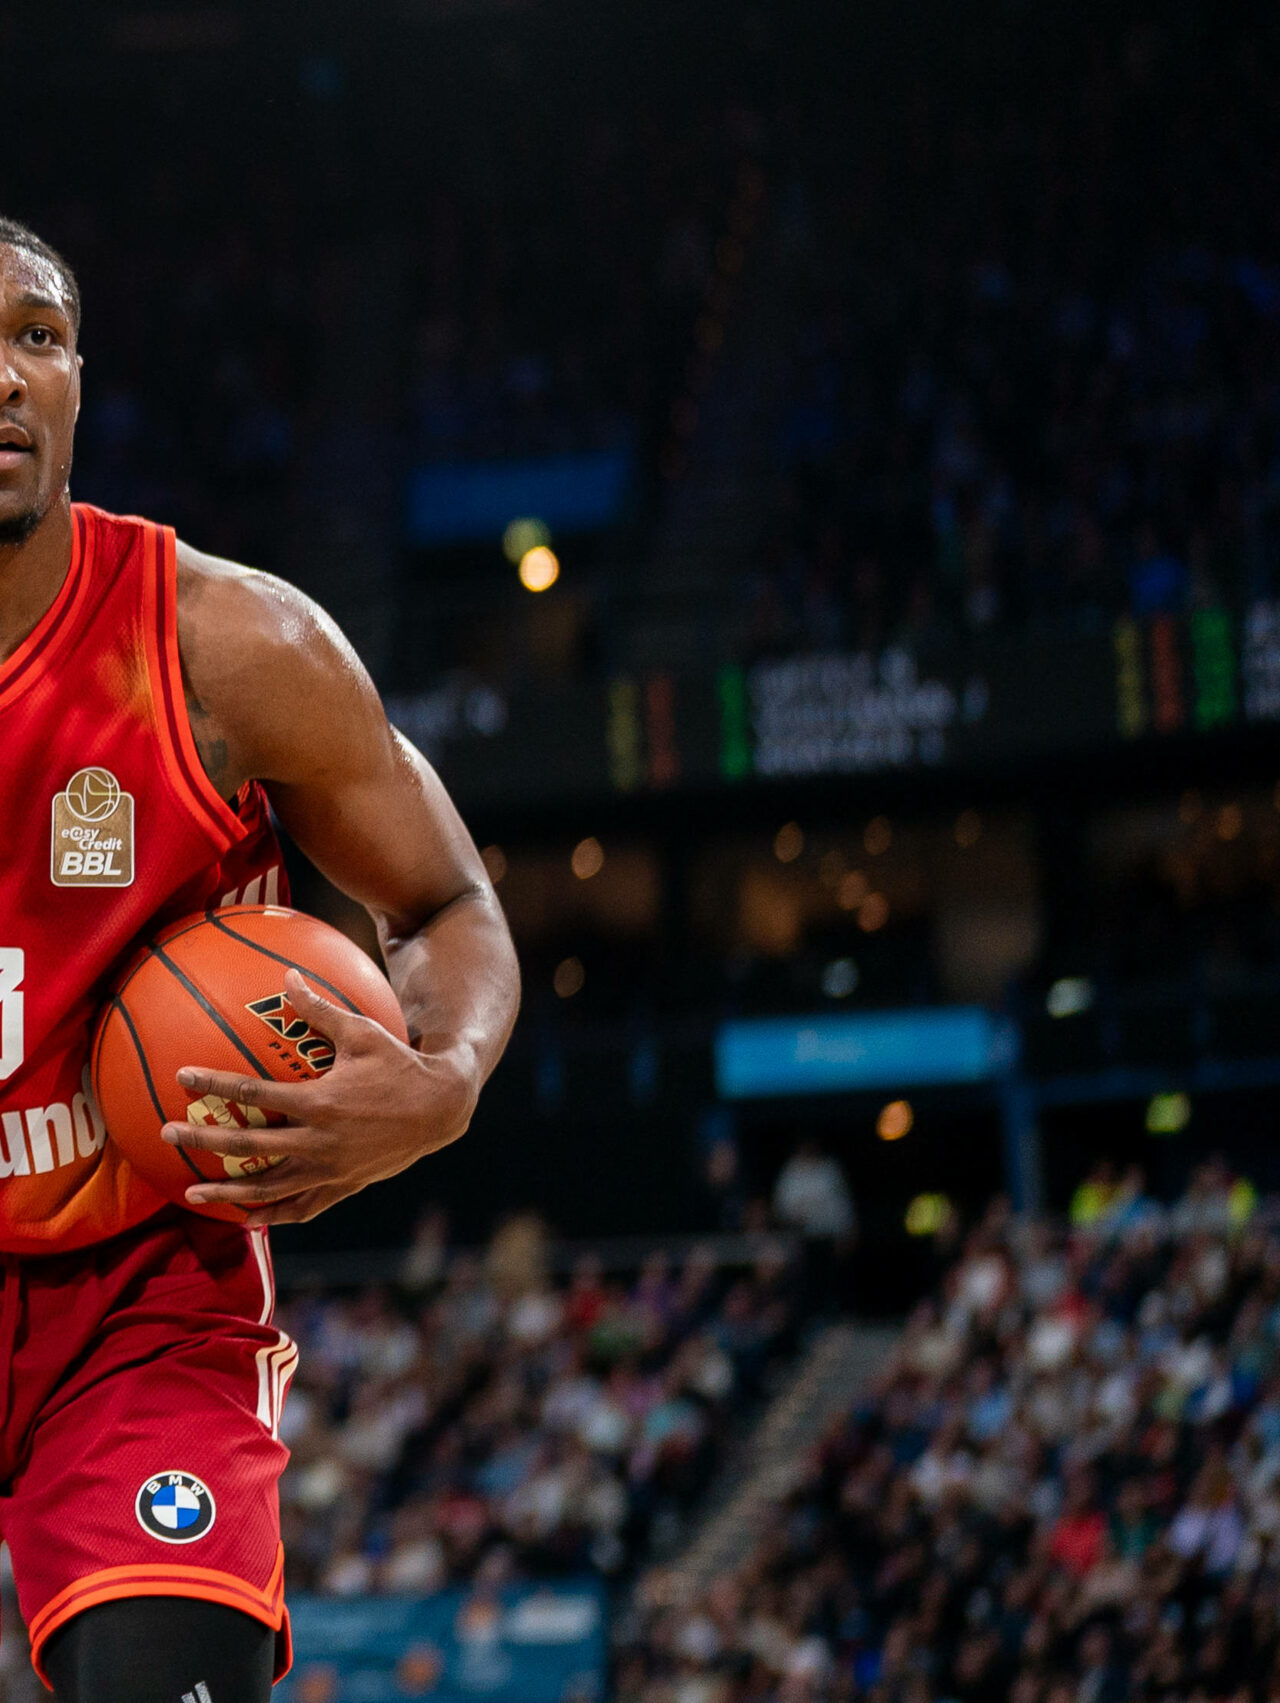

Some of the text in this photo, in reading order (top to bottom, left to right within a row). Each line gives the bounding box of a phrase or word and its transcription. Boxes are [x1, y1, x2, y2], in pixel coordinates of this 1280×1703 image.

[78, 837, 123, 851] Credit
[60, 851, 123, 876] BBL
[146, 1475, 205, 1496] BMW
